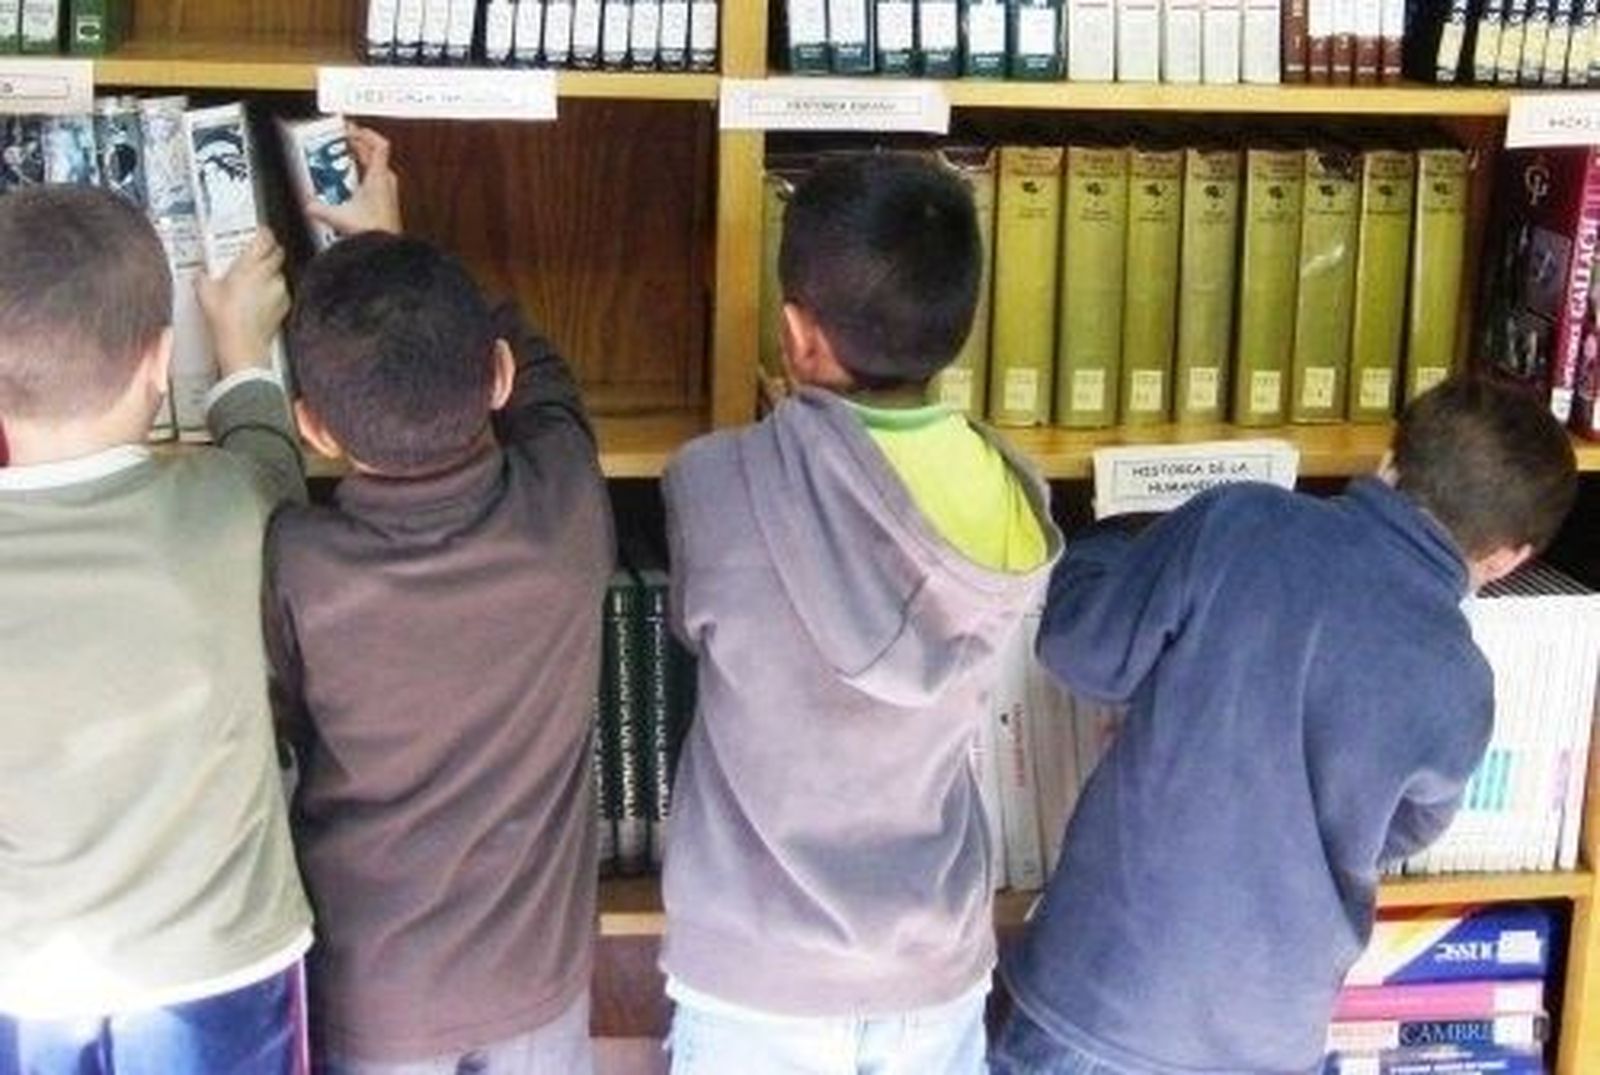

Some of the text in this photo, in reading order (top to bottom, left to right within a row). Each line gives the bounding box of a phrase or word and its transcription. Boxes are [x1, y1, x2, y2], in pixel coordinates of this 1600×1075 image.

[1132, 461, 1248, 478] HISTORIA DE LA
[1401, 1022, 1493, 1046] CAMBRI
